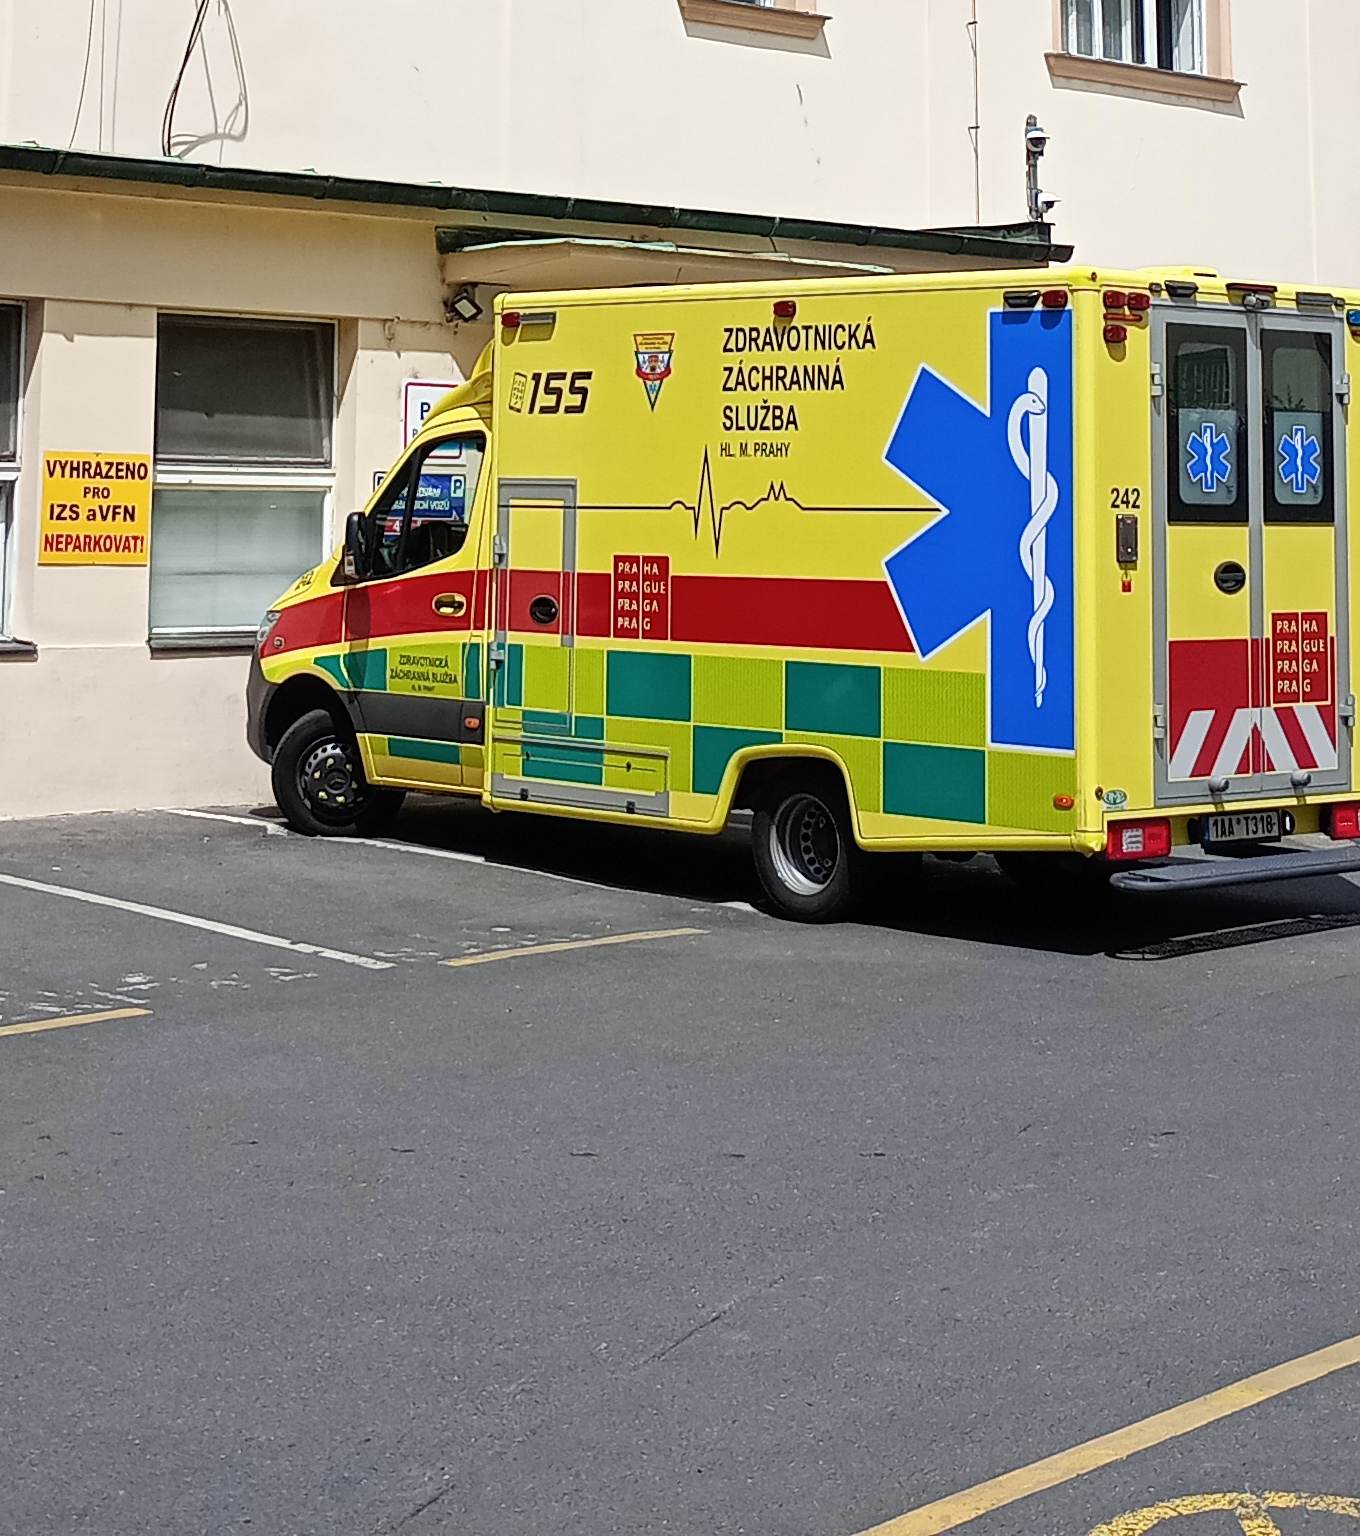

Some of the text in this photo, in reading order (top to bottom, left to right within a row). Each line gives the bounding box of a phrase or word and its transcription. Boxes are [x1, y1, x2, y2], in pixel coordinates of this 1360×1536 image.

[722, 315, 877, 353] ZDRAVOTNICKÁ
[722, 357, 845, 392] ZÁCHRANNÁ
[528, 371, 593, 414] 155
[722, 398, 799, 431] SLUŽBA
[754, 442, 790, 457] PRAHY
[46, 459, 149, 481] VYHRAZENO
[83, 486, 111, 499] PRO
[1110, 487, 1141, 509] 242
[49, 503, 80, 521] IZS
[43, 533, 145, 554] NEPARKOVAT!
[1212, 817, 1235, 838] 1AA
